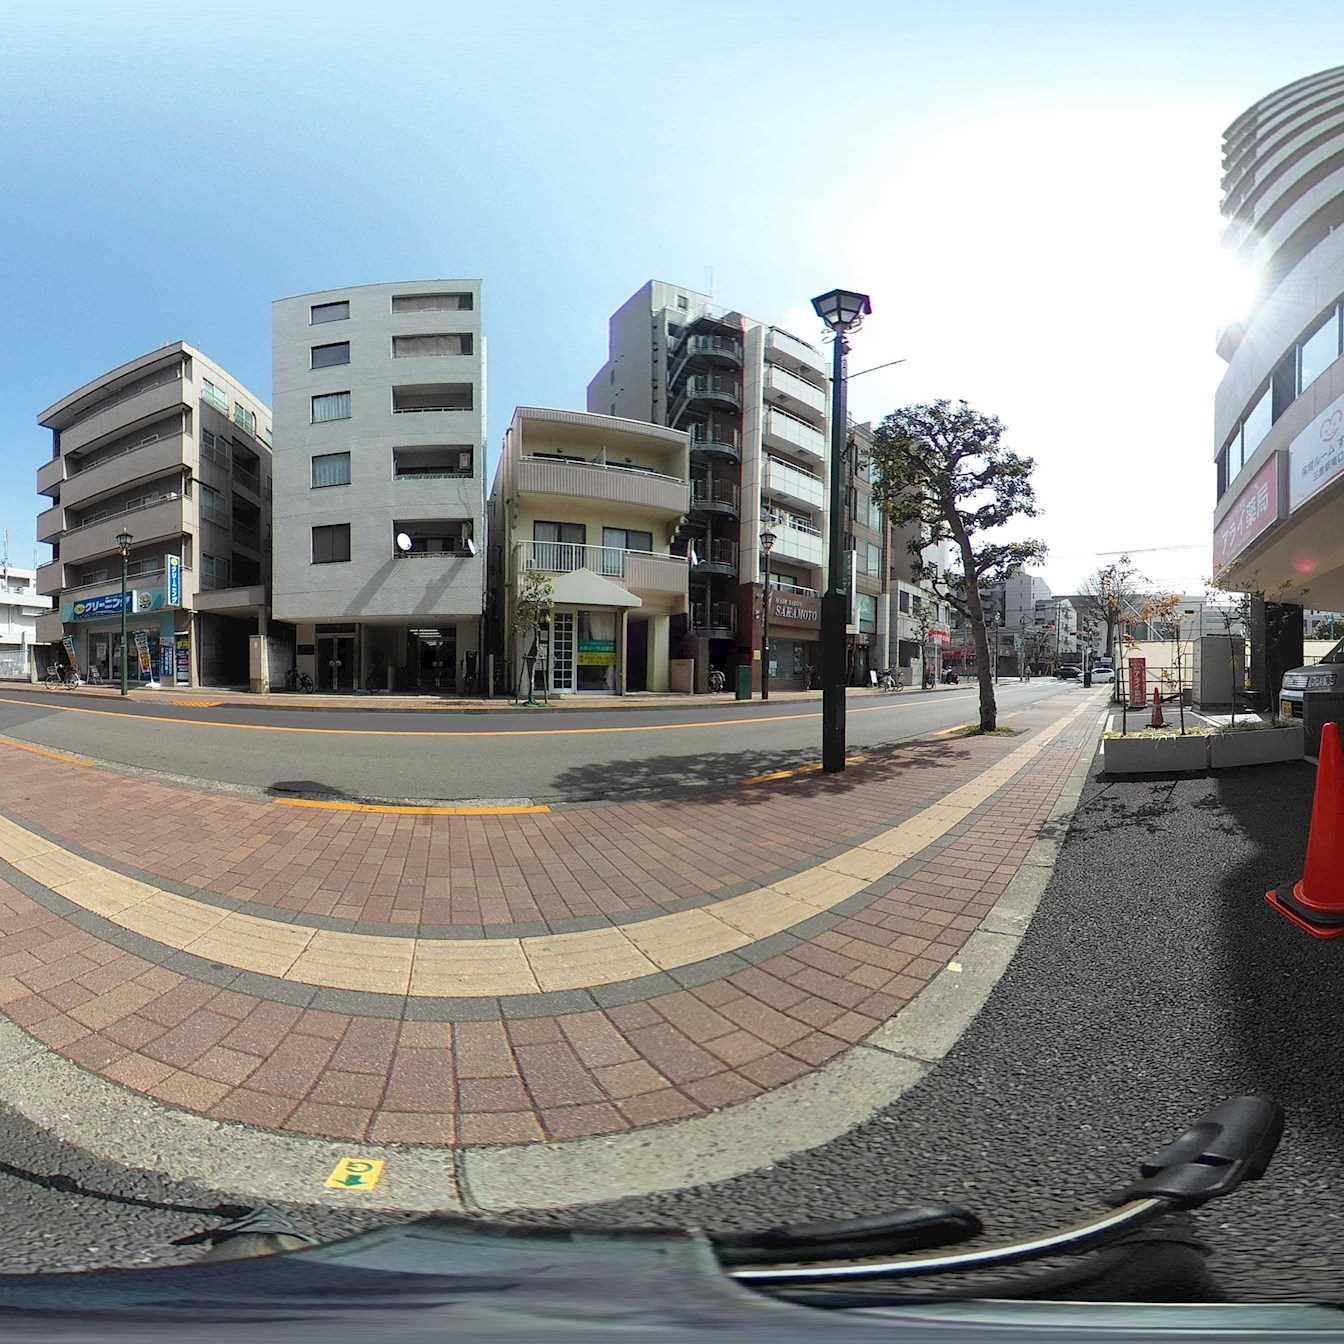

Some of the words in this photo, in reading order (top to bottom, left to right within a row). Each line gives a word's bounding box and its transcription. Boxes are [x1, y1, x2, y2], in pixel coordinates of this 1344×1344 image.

[1221, 481, 1268, 554] アライ薬局
[775, 604, 817, 620] SAKAMOTO
